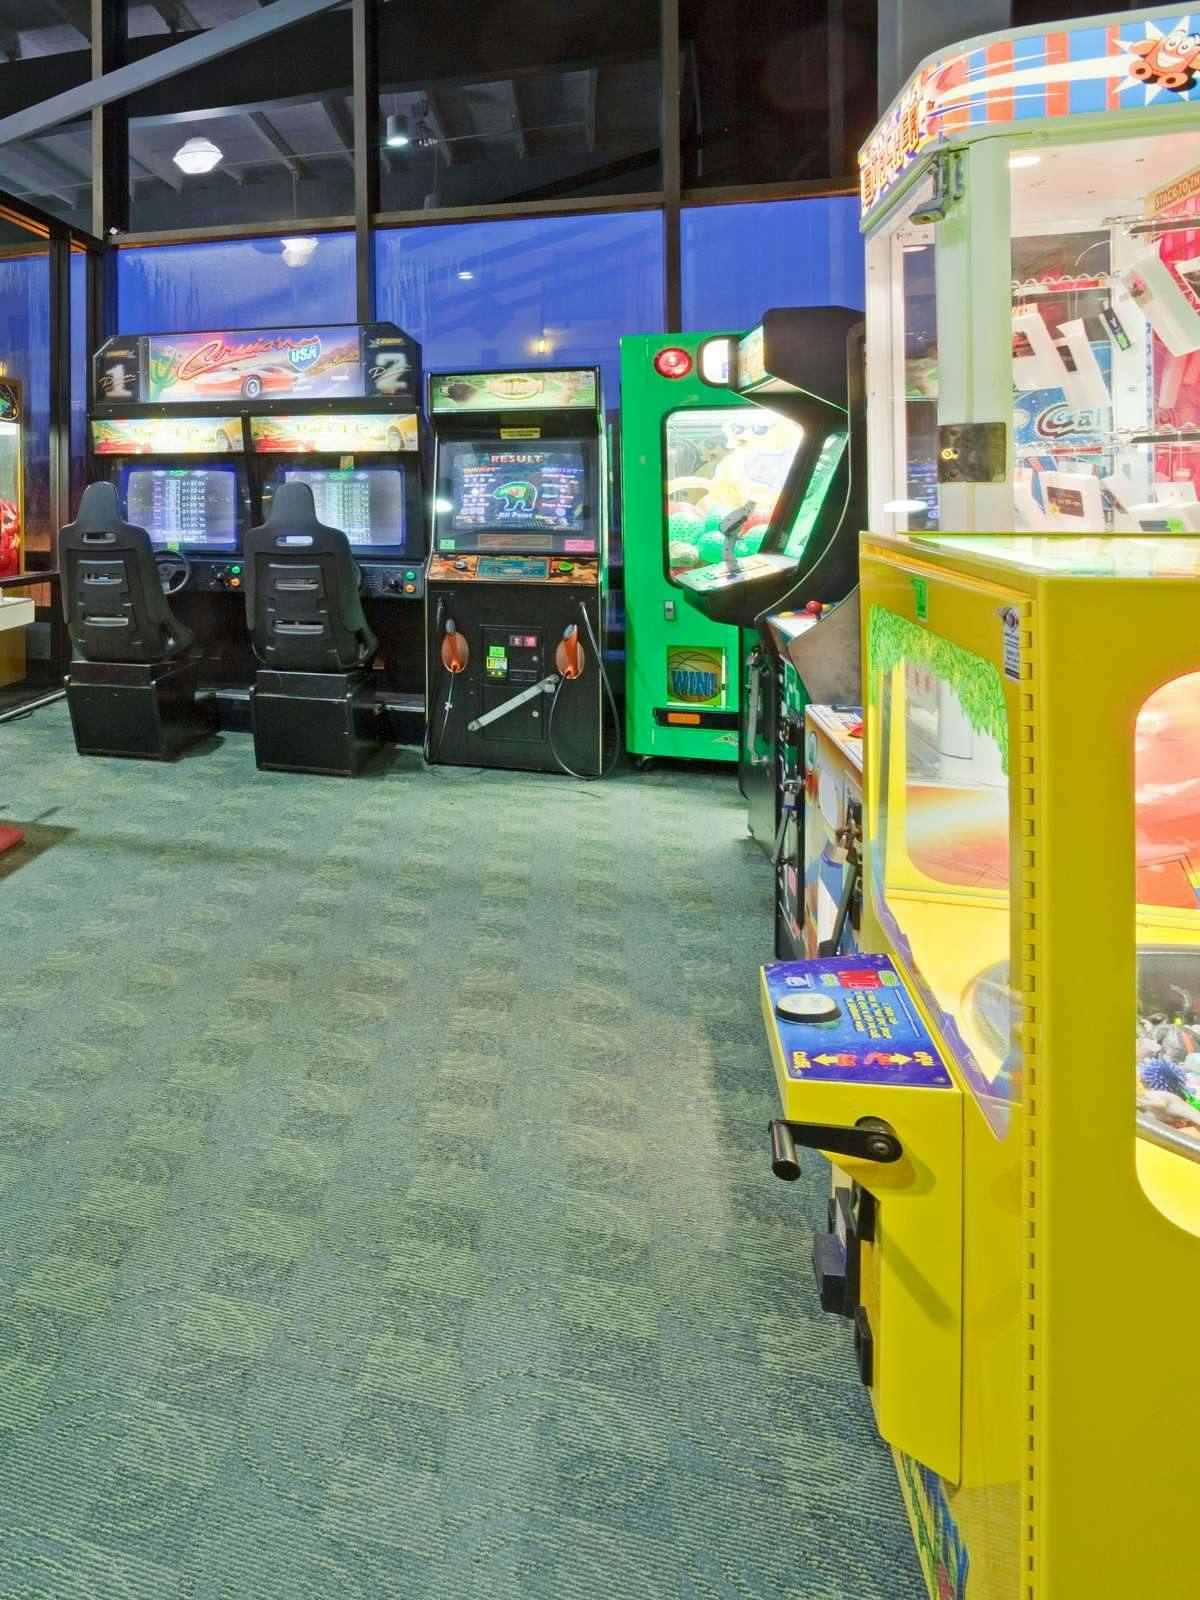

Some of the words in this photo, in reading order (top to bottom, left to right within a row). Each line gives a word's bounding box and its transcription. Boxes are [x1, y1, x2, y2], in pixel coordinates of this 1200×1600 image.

[291, 347, 318, 363] USA
[106, 364, 132, 398] 1
[376, 353, 407, 389] 2
[491, 454, 544, 463] RESULT
